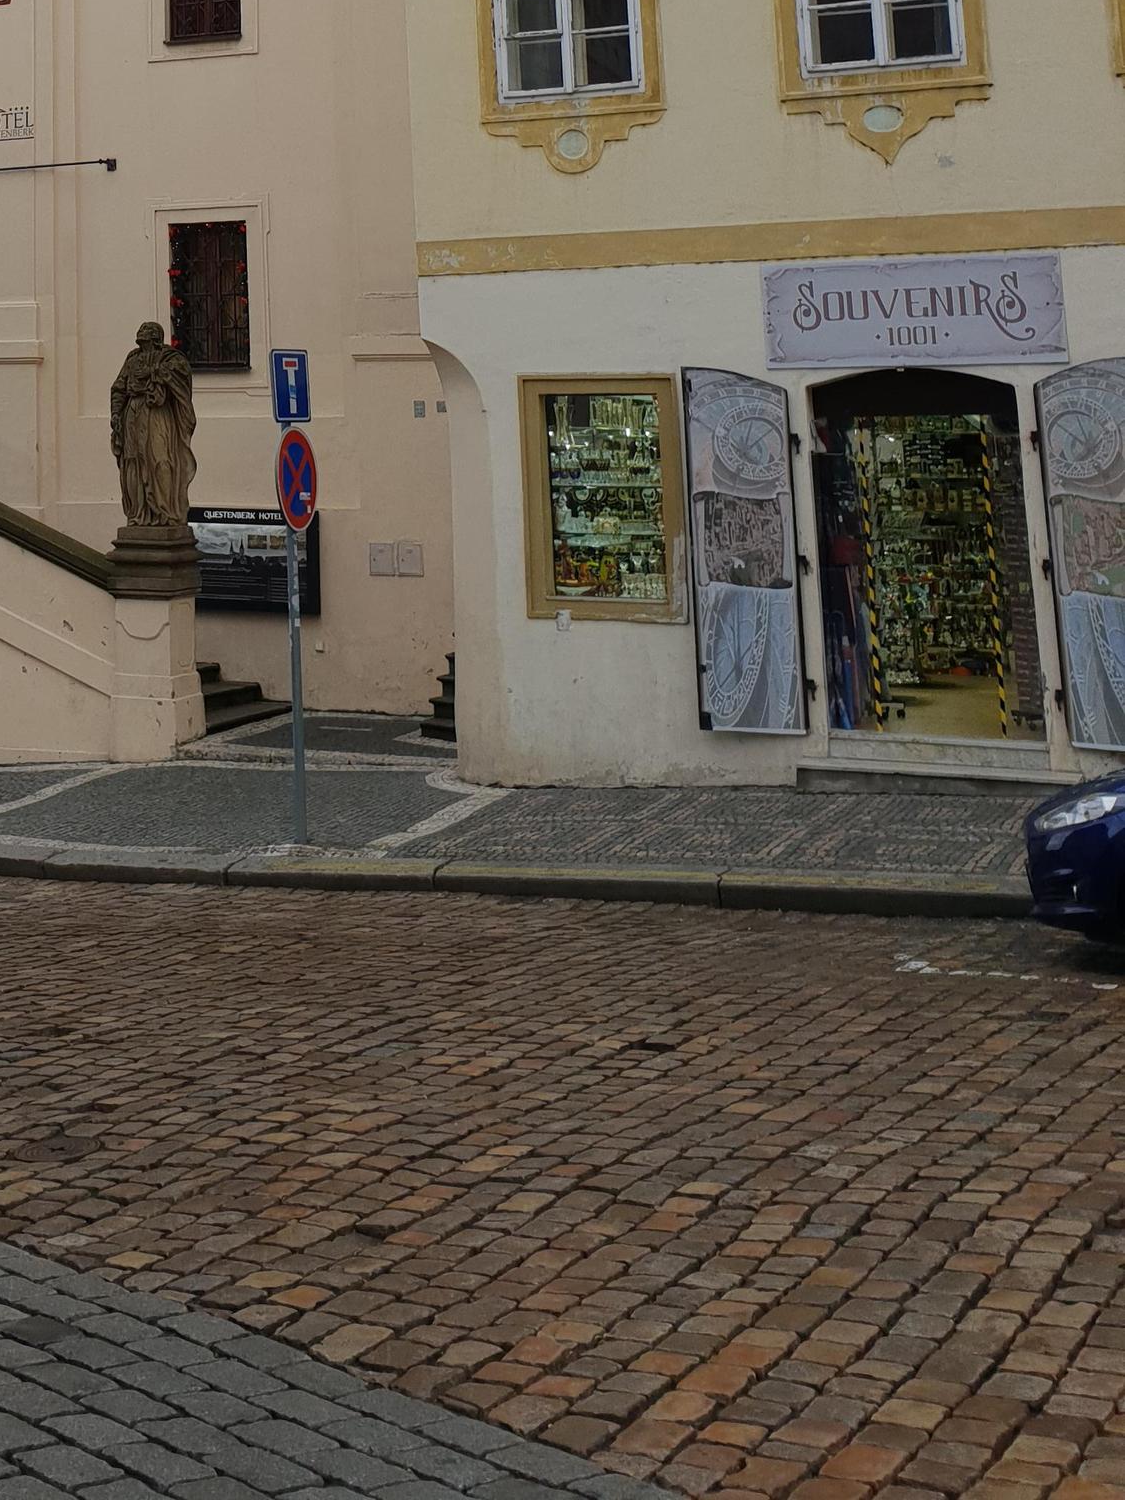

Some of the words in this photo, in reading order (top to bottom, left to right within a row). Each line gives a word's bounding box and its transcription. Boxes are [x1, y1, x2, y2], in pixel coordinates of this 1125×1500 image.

[792, 271, 1035, 341] SOUVENIRS
[886, 325, 938, 347] 1001
[203, 510, 257, 520] QUESTENBERK
[258, 512, 283, 521] HOTEL
